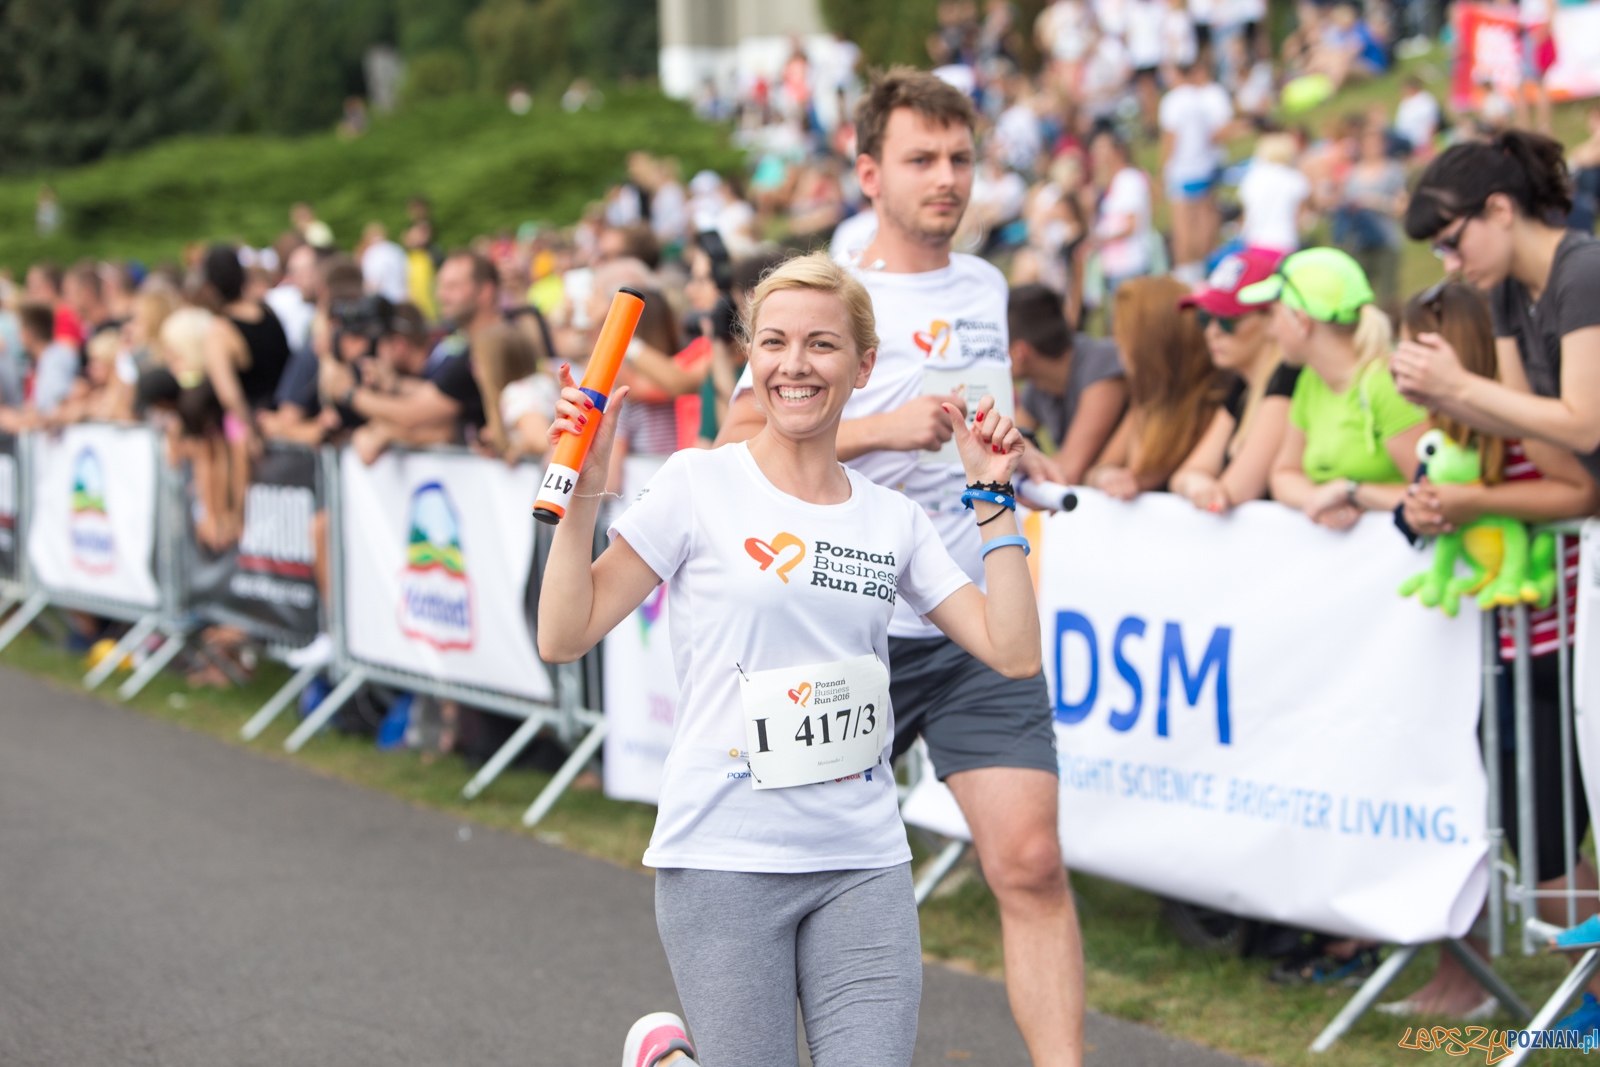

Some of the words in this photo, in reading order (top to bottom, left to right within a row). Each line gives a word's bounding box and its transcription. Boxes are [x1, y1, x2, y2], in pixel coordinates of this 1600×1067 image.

[543, 473, 573, 495] 417
[814, 541, 896, 567] Poznań
[810, 571, 858, 593] Run
[812, 555, 898, 588] Business
[815, 678, 846, 689] Poznań
[1055, 610, 1231, 745] DSM
[814, 686, 850, 697] Business
[832, 693, 850, 702] 2016
[752, 717, 773, 753] I
[794, 703, 876, 746] 417/3
[1225, 778, 1332, 830] BRIGHTER
[1338, 797, 1469, 845] LIVING.
